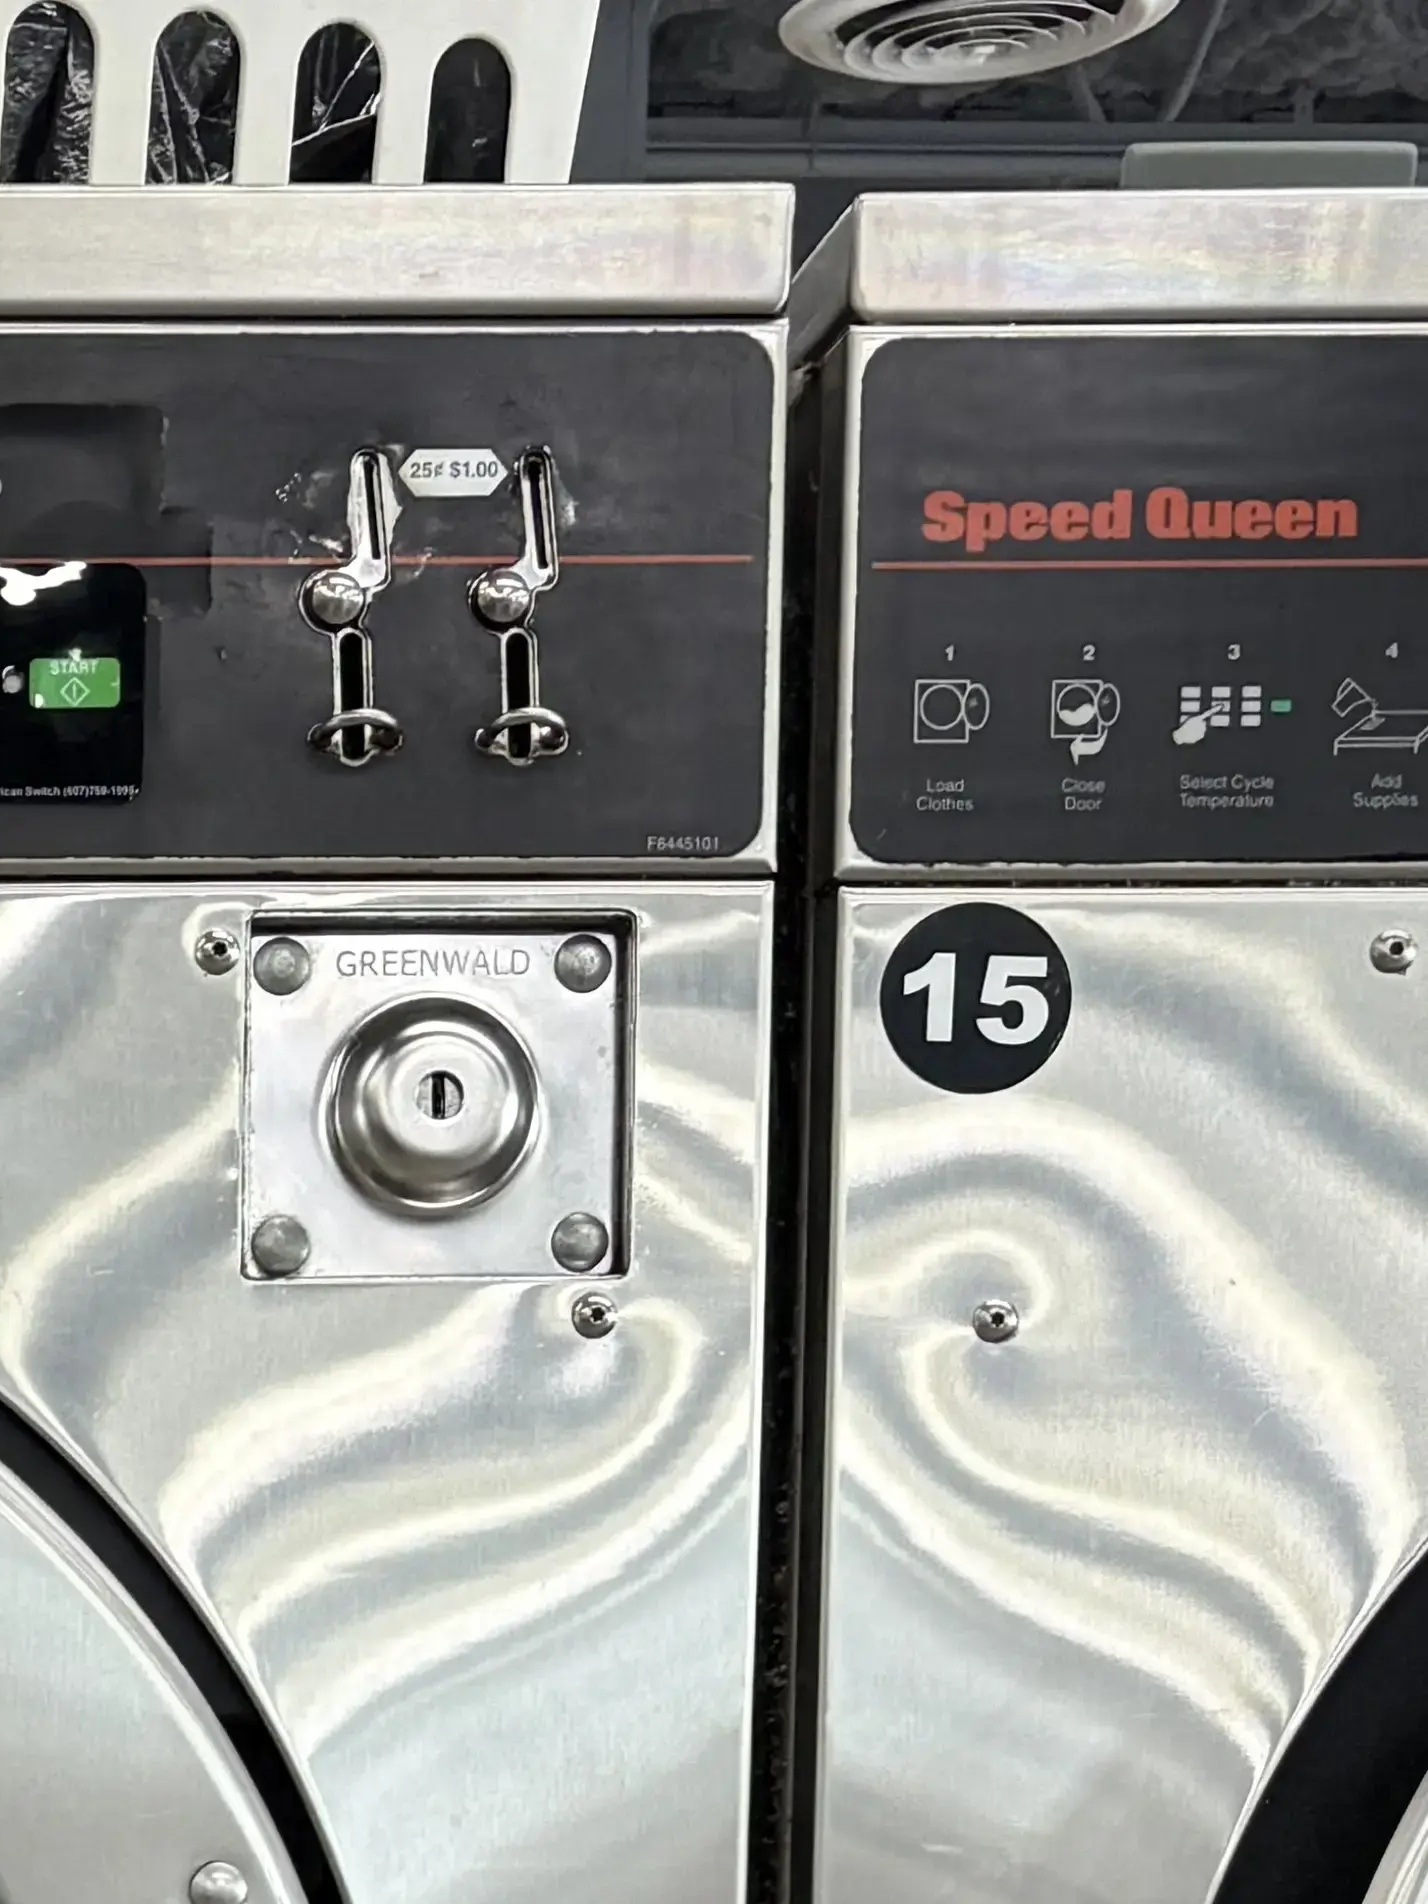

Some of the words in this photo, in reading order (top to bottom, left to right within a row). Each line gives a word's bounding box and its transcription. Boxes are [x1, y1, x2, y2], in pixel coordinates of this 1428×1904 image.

[450, 461, 498, 478] $1.00
[922, 490, 1133, 553] Speed
[1146, 487, 1358, 539] Queen
[945, 645, 955, 660] 1
[1083, 645, 1095, 660] 2
[1228, 644, 1240, 660] 3
[1385, 643, 1398, 658] 4
[50, 660, 99, 675] START
[926, 778, 964, 793] Load
[1062, 778, 1105, 793] Close
[1180, 775, 1227, 790] Select
[1232, 775, 1274, 793] Cycle
[1371, 774, 1402, 789] Add
[26, 786, 60, 796] Switch
[917, 796, 973, 811] Clothes
[1065, 797, 1101, 811] Door
[1180, 793, 1273, 810] Temperature
[1353, 793, 1418, 810] Supplies
[335, 948, 532, 980] GREENWALD
[903, 951, 1051, 1045] 15
